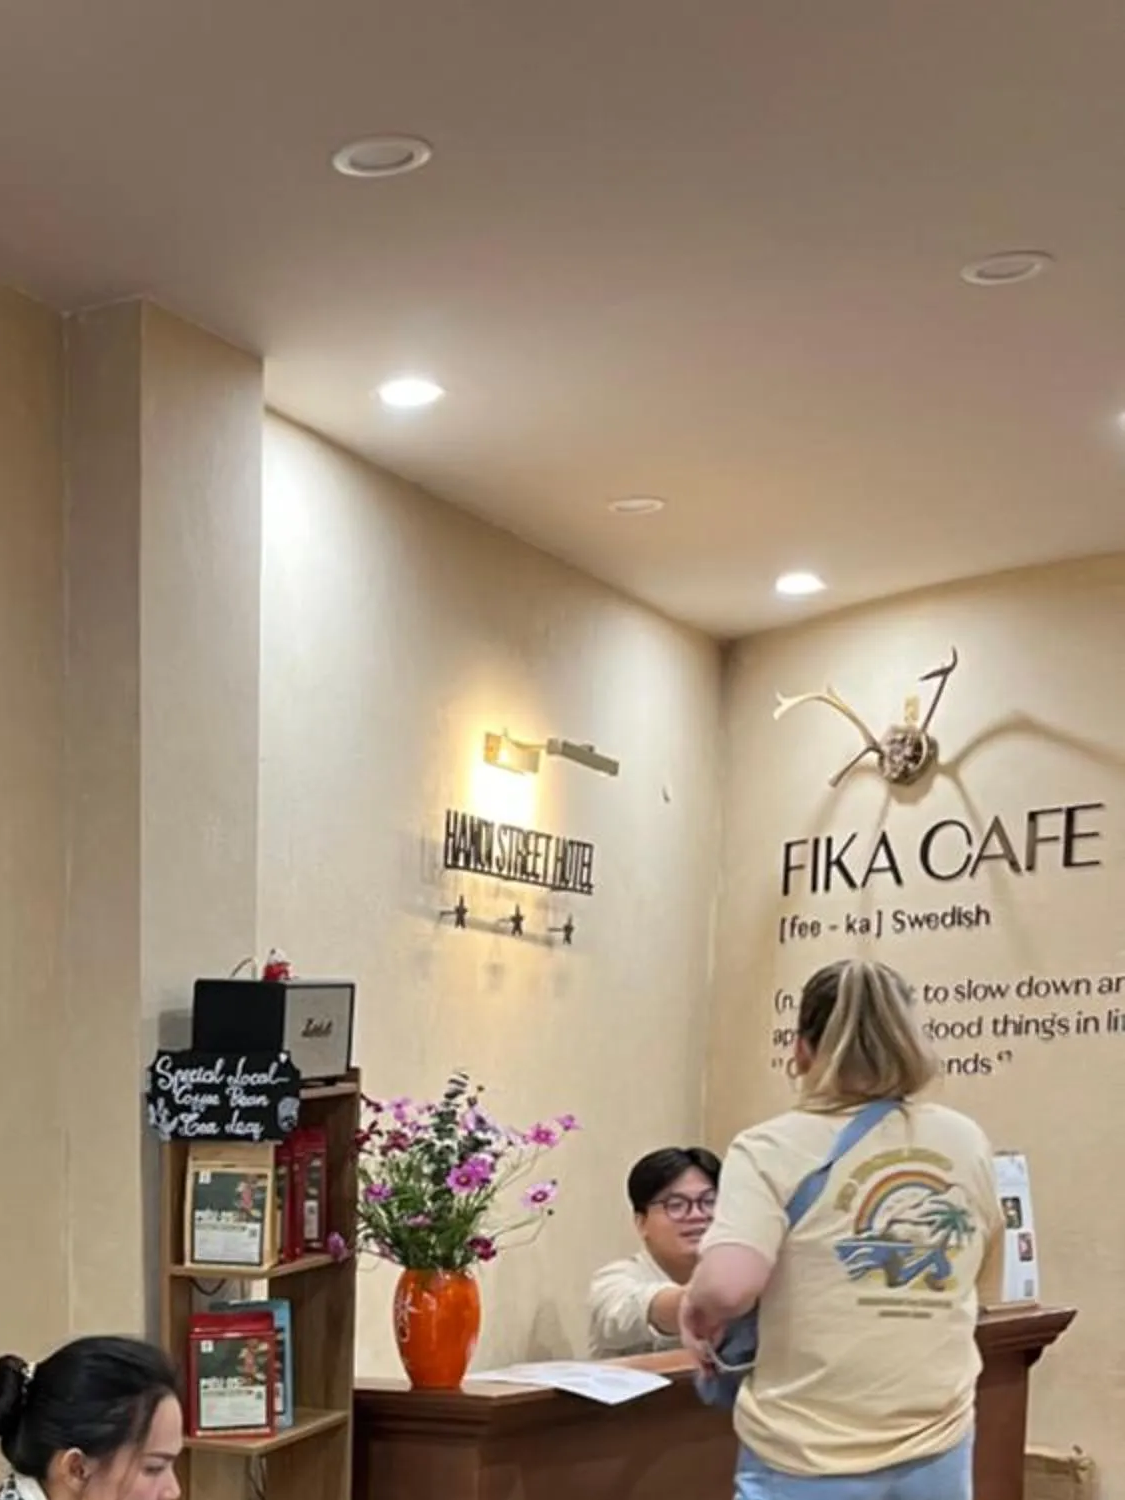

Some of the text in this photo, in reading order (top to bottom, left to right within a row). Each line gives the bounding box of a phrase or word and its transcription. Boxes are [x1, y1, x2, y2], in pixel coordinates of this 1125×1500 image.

[444, 809, 595, 889] HANOI STREET HOTEL
[782, 802, 1105, 896] FIKA CAFE
[891, 904, 990, 934] Swedish
[923, 982, 948, 1004] to
[954, 978, 1010, 1002] slow
[1015, 976, 1091, 998] down
[991, 1012, 1070, 1041] things
[1075, 1010, 1100, 1035] in
[155, 1055, 289, 1094] Special Local
